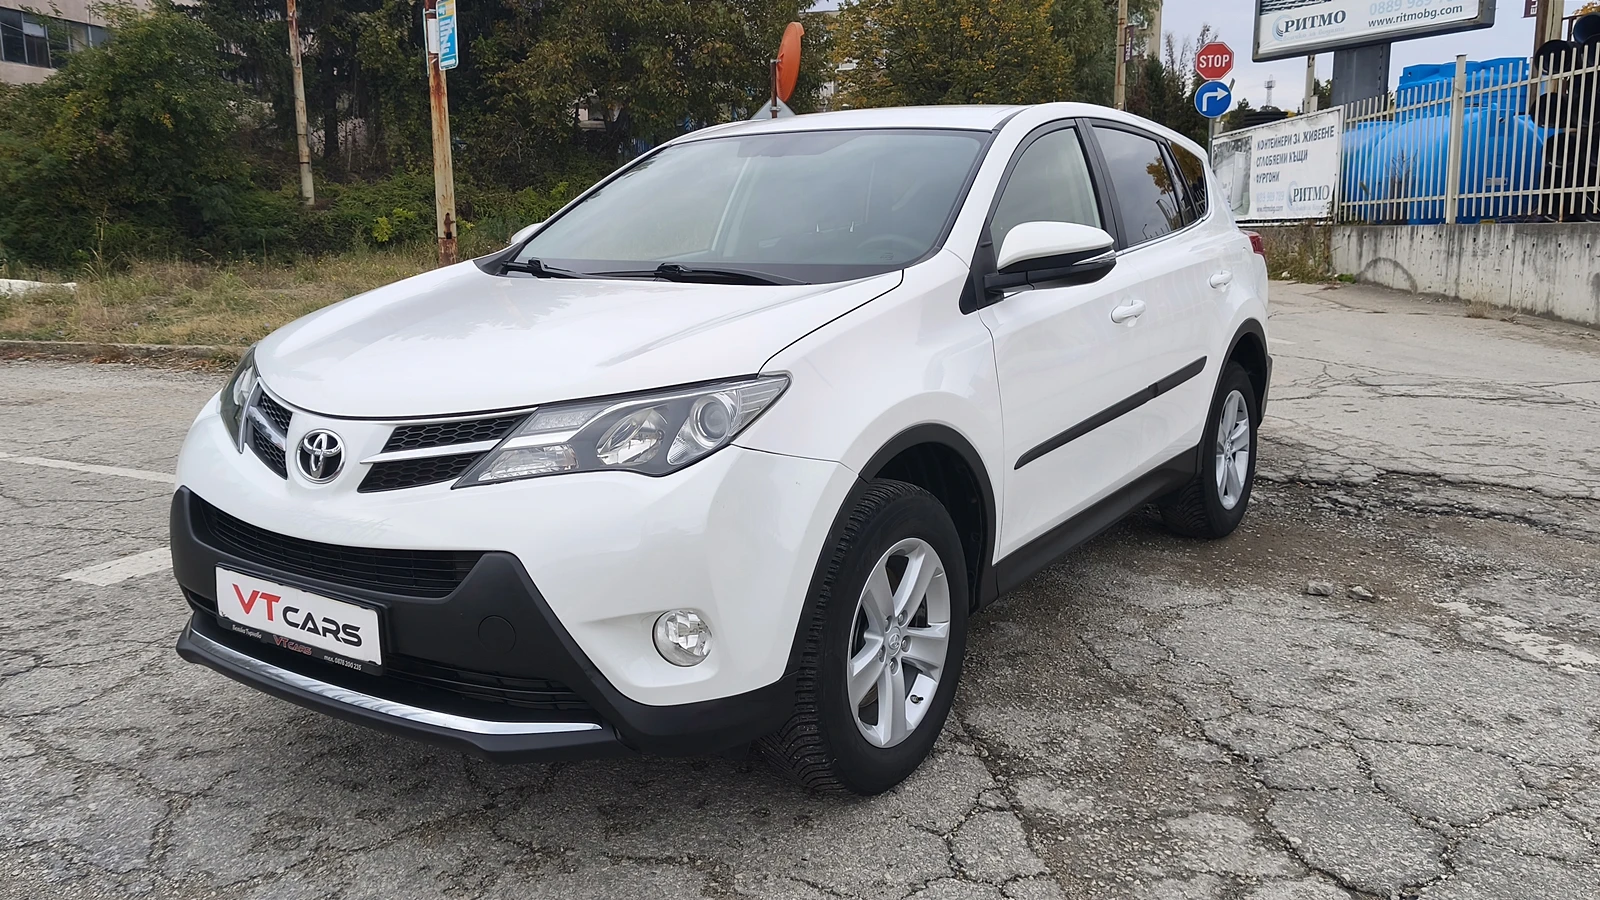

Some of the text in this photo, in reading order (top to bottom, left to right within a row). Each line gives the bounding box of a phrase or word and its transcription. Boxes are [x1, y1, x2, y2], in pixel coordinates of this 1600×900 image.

[1368, 5, 1463, 27] www.ritmobg.com
[1369, 0, 1402, 16] 0889
[1284, 10, 1347, 33] РИТМО
[1199, 54, 1230, 68] STOP
[1256, 133, 1293, 151] КОНТЕЙНЕРИ
[1302, 125, 1335, 143] ЖИВЕЕНЕ
[1256, 149, 1308, 167] СГЛОБЯЕМИ КЪЩИ
[1292, 185, 1330, 202] РИТМО
[232, 583, 362, 647] VT CARS
